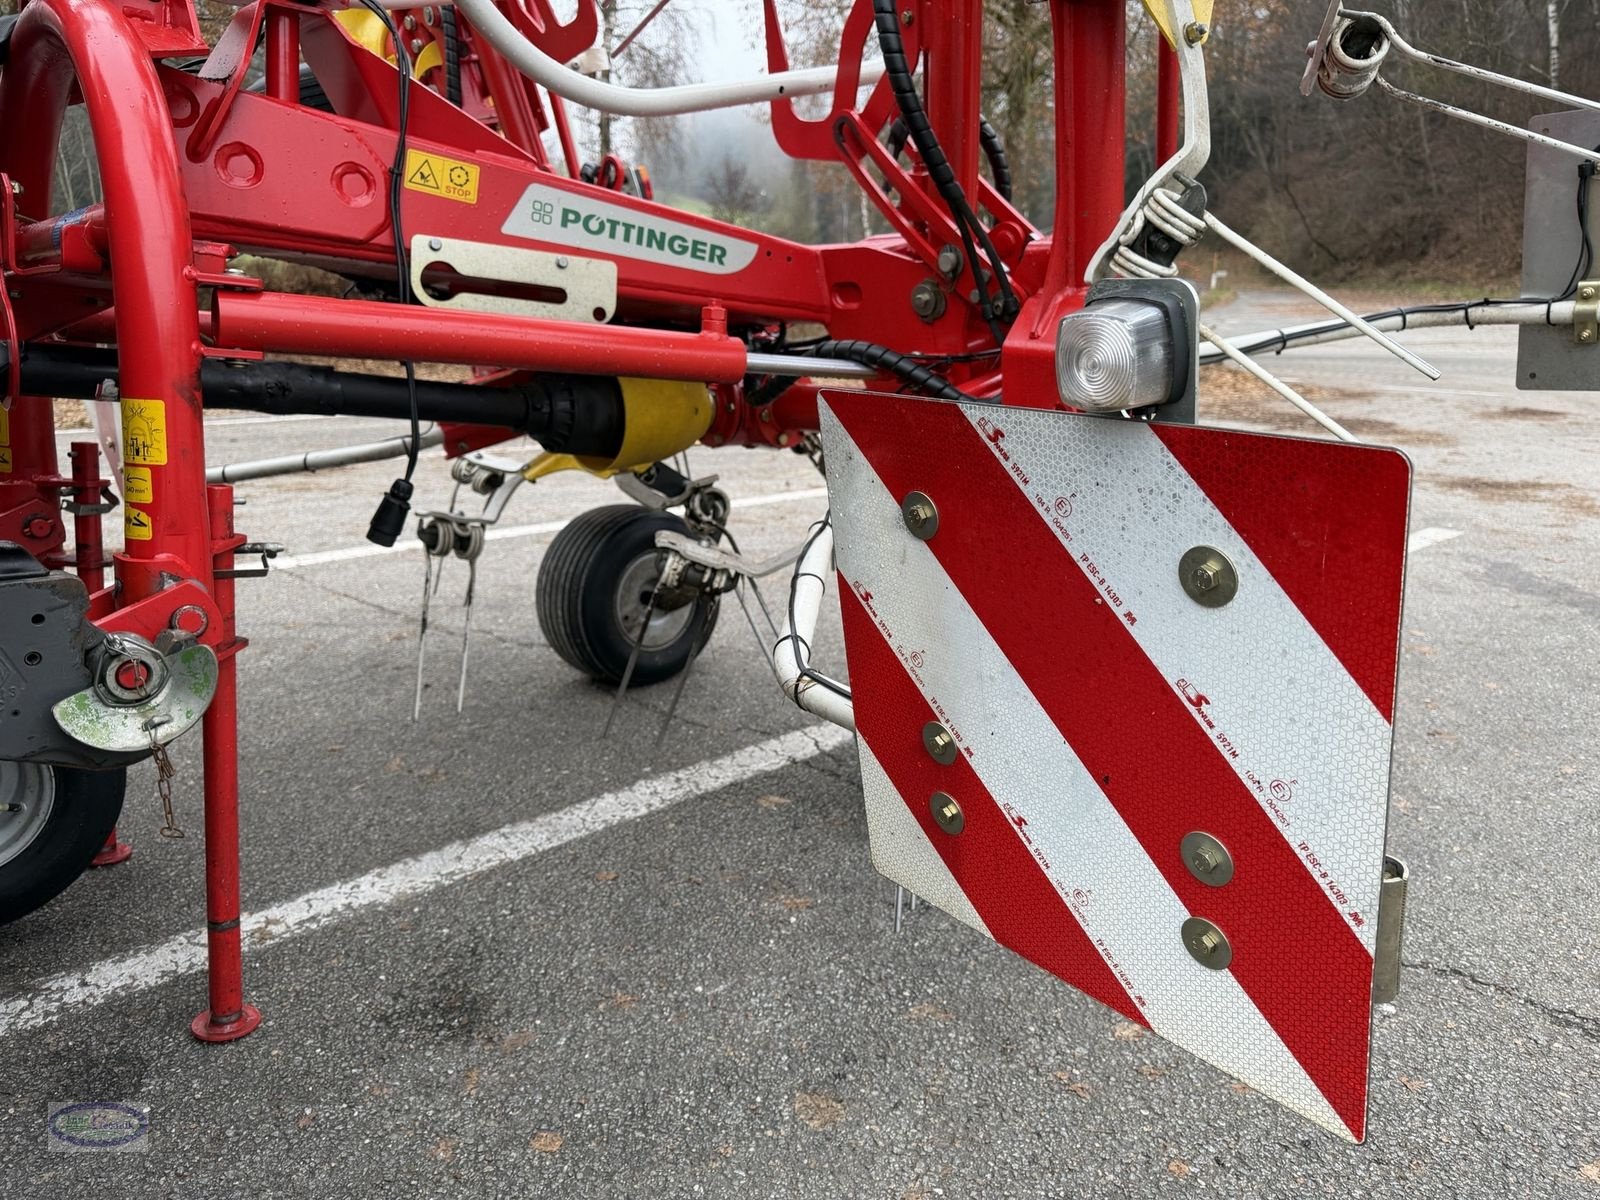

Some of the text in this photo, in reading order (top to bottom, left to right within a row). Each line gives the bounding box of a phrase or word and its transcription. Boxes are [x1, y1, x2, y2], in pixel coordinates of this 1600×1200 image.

[445, 186, 471, 199] STOP
[1011, 462, 1030, 486] 5921M
[1104, 585, 1123, 607] 14303
[1216, 733, 1239, 759] 5921M
[1326, 880, 1348, 905] 14303
